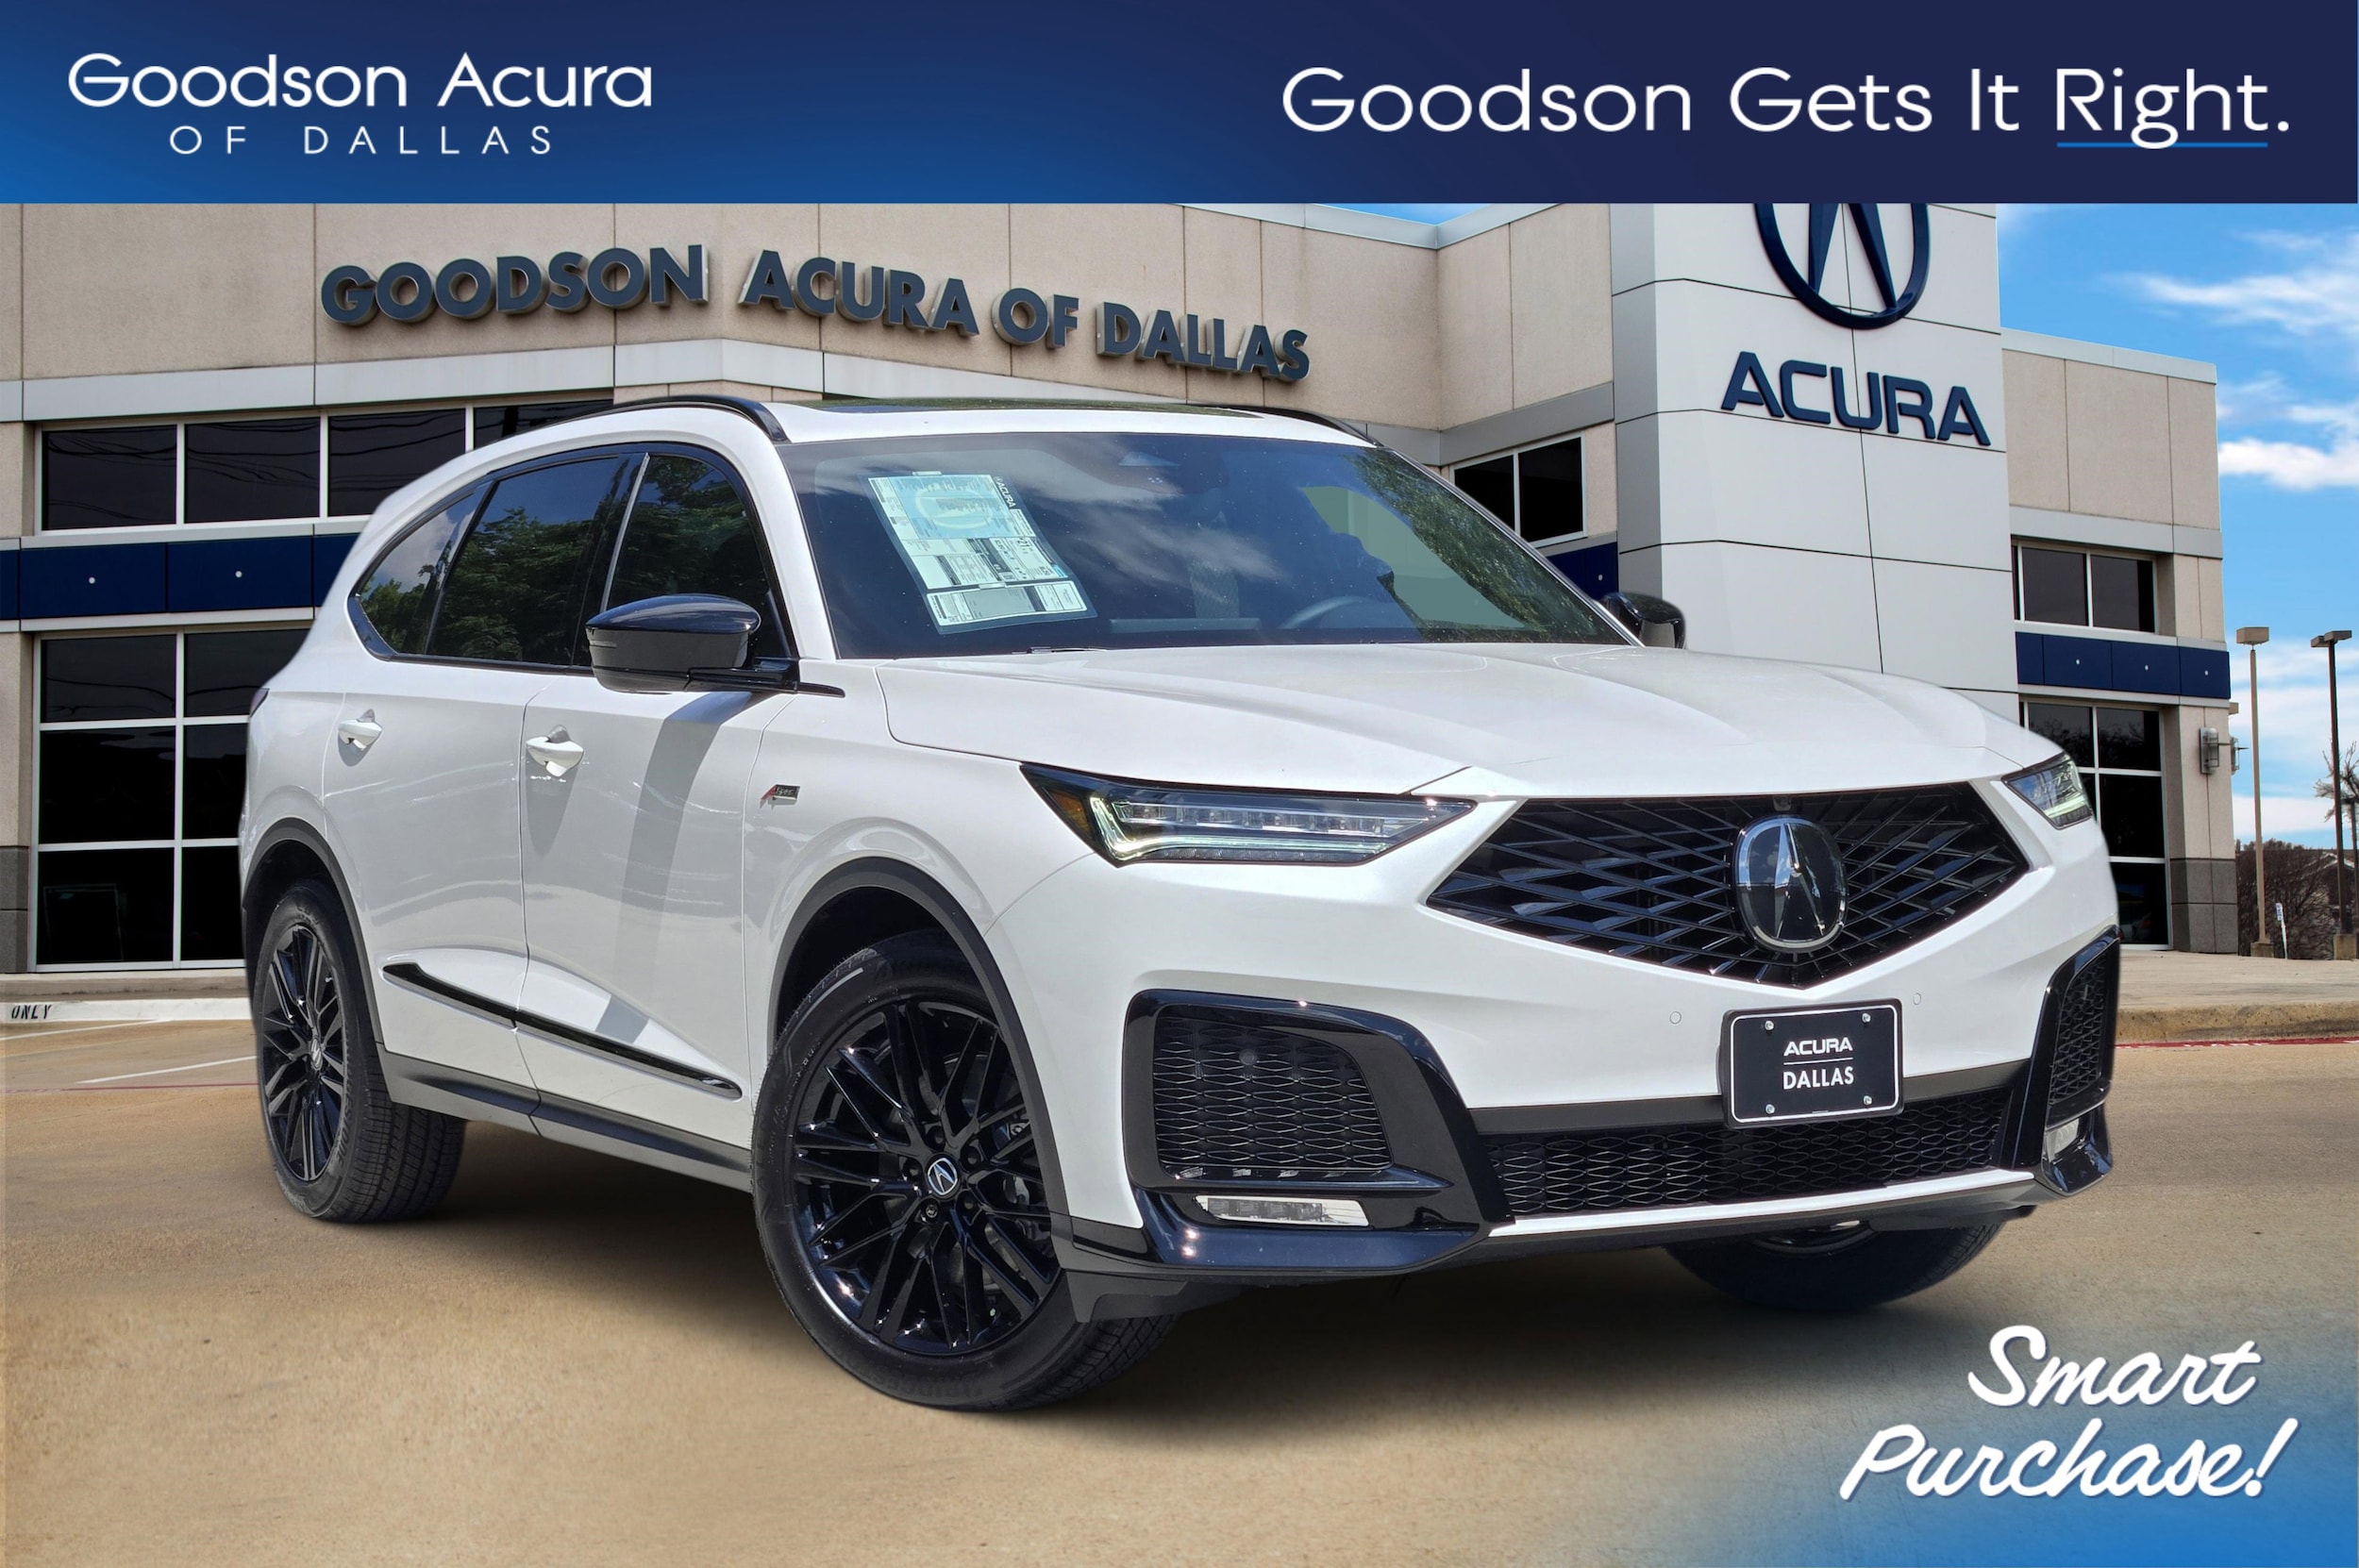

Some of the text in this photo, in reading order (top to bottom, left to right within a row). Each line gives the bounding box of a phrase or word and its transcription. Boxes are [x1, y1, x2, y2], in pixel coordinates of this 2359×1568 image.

[321, 244, 1310, 383] GOODSON ACURA OF DALLAS
[1720, 351, 1991, 446] ACURA
[996, 481, 1016, 509] ACURA
[10, 1004, 52, 1020] ONLY
[1783, 1038, 1853, 1056] ACURA
[1783, 1066, 1855, 1090] DALLAS
